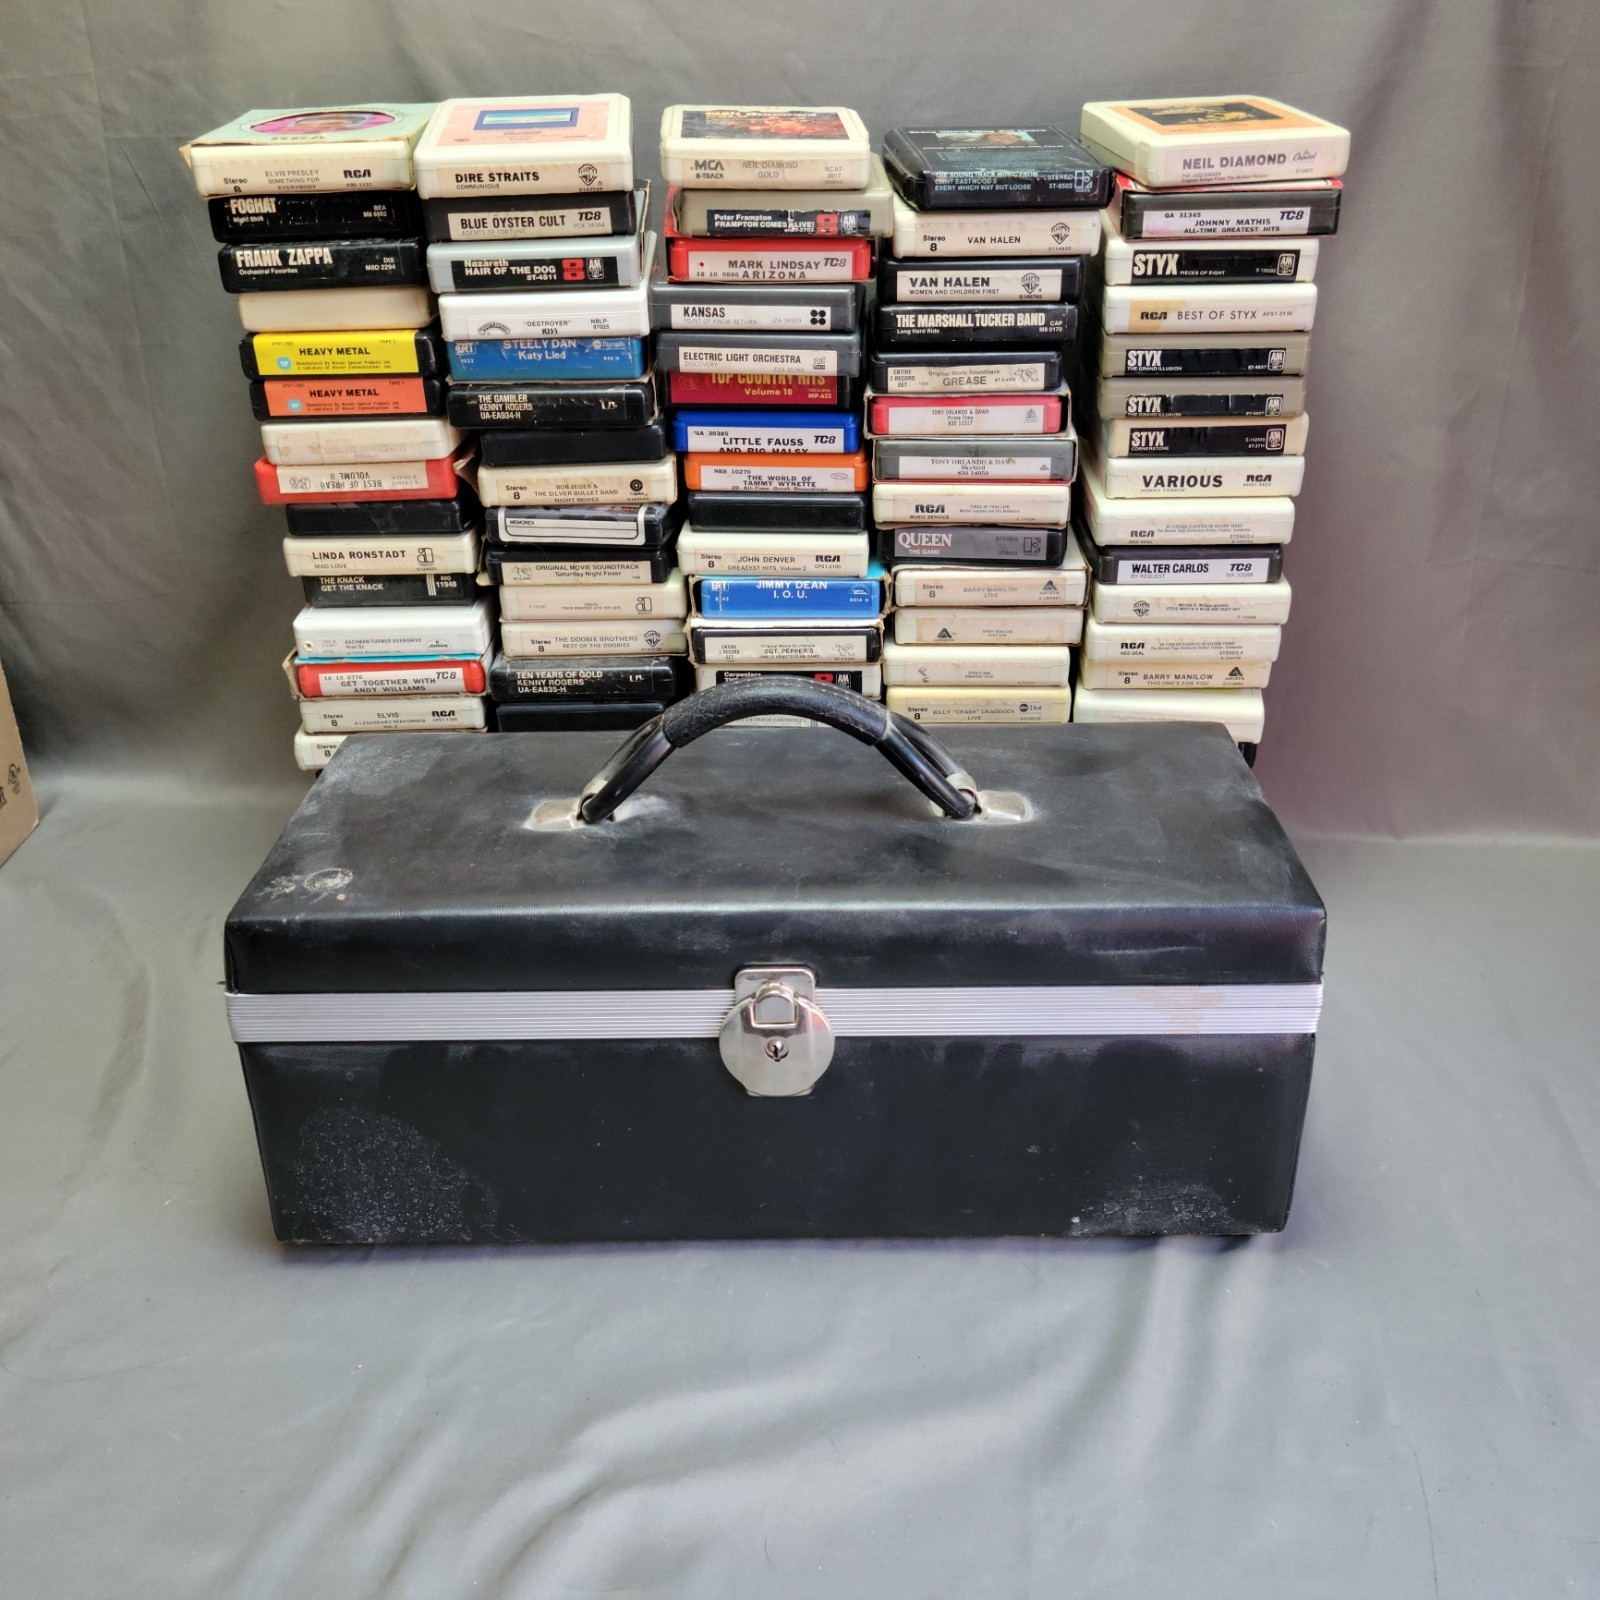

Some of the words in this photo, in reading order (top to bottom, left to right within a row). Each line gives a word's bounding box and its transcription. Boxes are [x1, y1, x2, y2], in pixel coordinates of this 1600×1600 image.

[1183, 158, 1215, 169] NEIL
[1220, 154, 1286, 167] DIAMOND
[455, 173, 484, 183] DIRE
[489, 171, 539, 182] STRAITS
[758, 171, 779, 179] GOLD
[223, 177, 248, 185] Stereo
[230, 198, 276, 214] FOGHAT
[930, 243, 937, 251] 8
[236, 250, 282, 268] FRANK
[288, 248, 333, 266] ZAPPA
[728, 260, 763, 269] MARK
[770, 261, 820, 269] LINDSAY
[1133, 254, 1178, 276] STYX
[465, 267, 491, 276] HAIR
[493, 267, 508, 275] OF
[510, 266, 531, 274] THE
[534, 265, 556, 273] DOG
[742, 271, 806, 279] ARIZONA
[910, 278, 938, 287] VAN
[944, 277, 990, 286] HALEN
[683, 306, 725, 318] KANSAS
[1178, 311, 1203, 319] BEST
[1209, 311, 1224, 319] OF
[1230, 311, 1257, 319] STYX
[896, 315, 915, 327] THE
[918, 314, 974, 327] MARSHALL
[975, 314, 1014, 326] TUCKER
[1017, 313, 1045, 326] BAND
[503, 339, 550, 349] STEELY
[552, 339, 576, 348] DAN
[299, 348, 333, 356] HEAVY
[337, 347, 370, 355] METAL
[518, 351, 544, 360] Katy
[547, 350, 566, 359] Lied
[683, 352, 723, 361] ELECTRIC
[726, 354, 749, 362] LIGHT
[753, 355, 801, 363] ORCHESTRA
[1128, 351, 1162, 366] STYX
[943, 377, 987, 386] GREASE
[310, 389, 343, 397] HEAVY
[346, 388, 379, 396] METAL
[478, 395, 493, 403] THE
[494, 394, 528, 403] GAMBLER
[505, 403, 533, 411] ROGERS
[1128, 397, 1161, 413] STYX
[767, 438, 803, 446] FAUSS
[1132, 431, 1164, 446] STYX
[1142, 475, 1223, 487] VARIOUS
[513, 492, 521, 500] 8
[898, 533, 952, 548] QUEEN
[350, 550, 406, 558] RONSTADT
[1132, 564, 1171, 573] WALTER
[1172, 564, 1209, 573] CARLOS
[756, 581, 791, 589] JIMMY
[795, 581, 827, 589] DEAN
[929, 590, 936, 598] 8
[331, 719, 338, 727] 8
